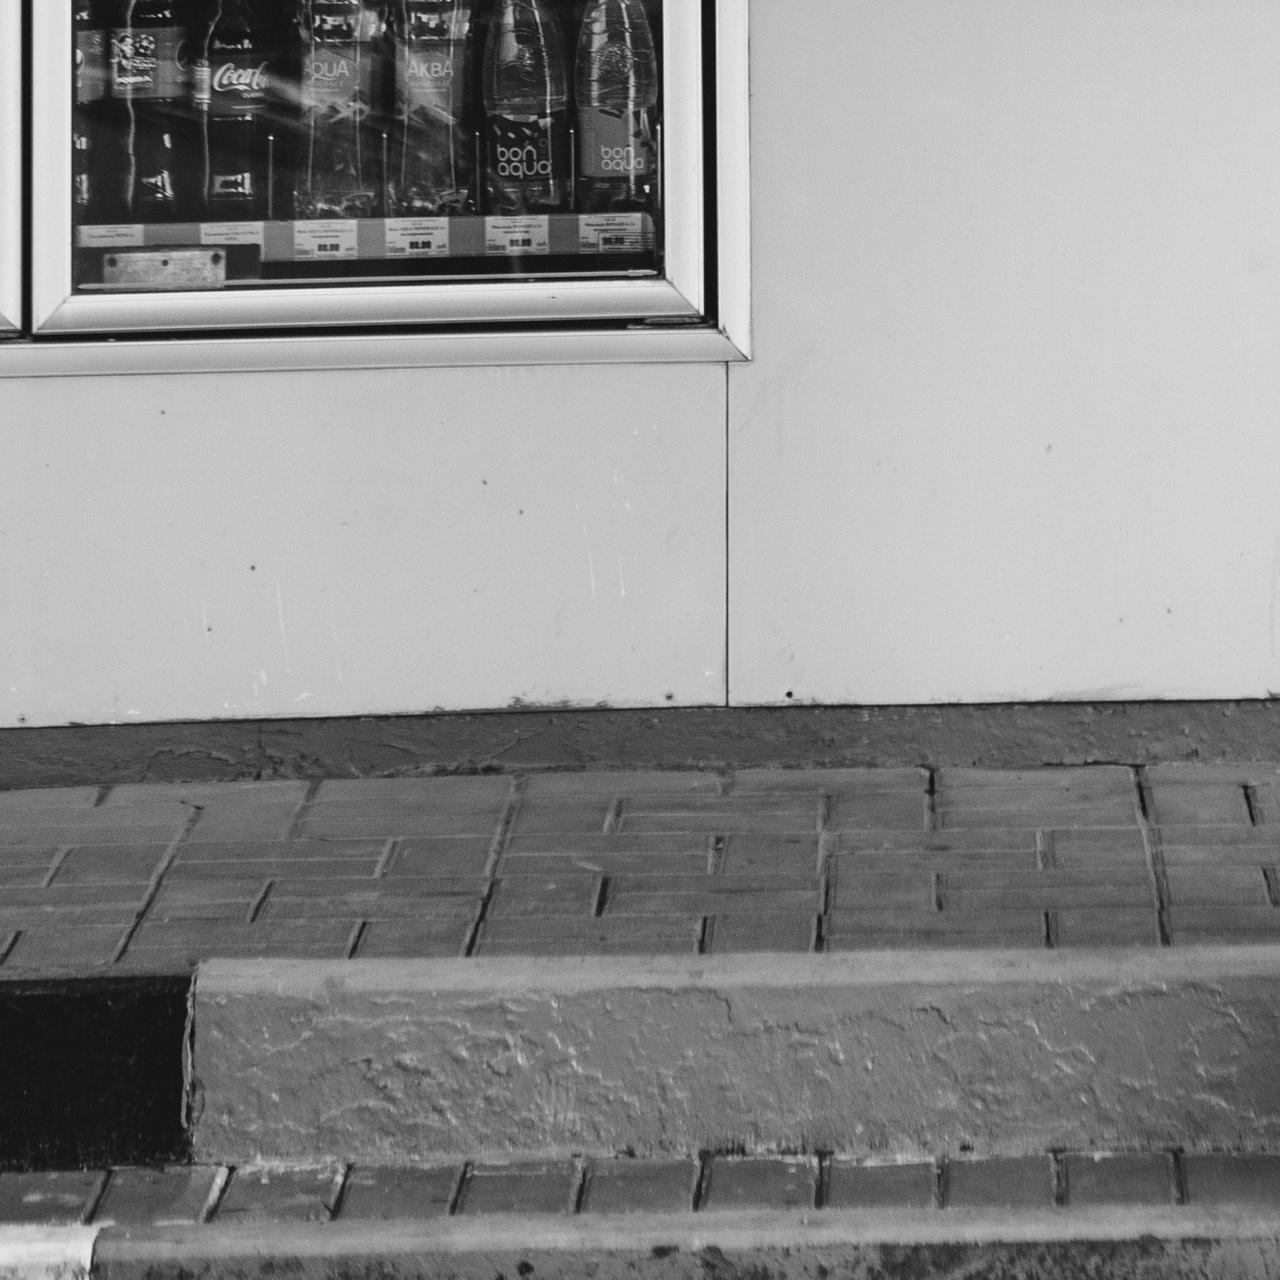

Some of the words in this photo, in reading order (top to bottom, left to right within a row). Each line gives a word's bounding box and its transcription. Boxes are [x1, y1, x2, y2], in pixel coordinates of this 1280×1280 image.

[304, 60, 349, 81] AQUA
[497, 141, 537, 161] bon
[601, 144, 633, 158] bon
[498, 160, 550, 179] aqua
[601, 158, 644, 172] aqua
